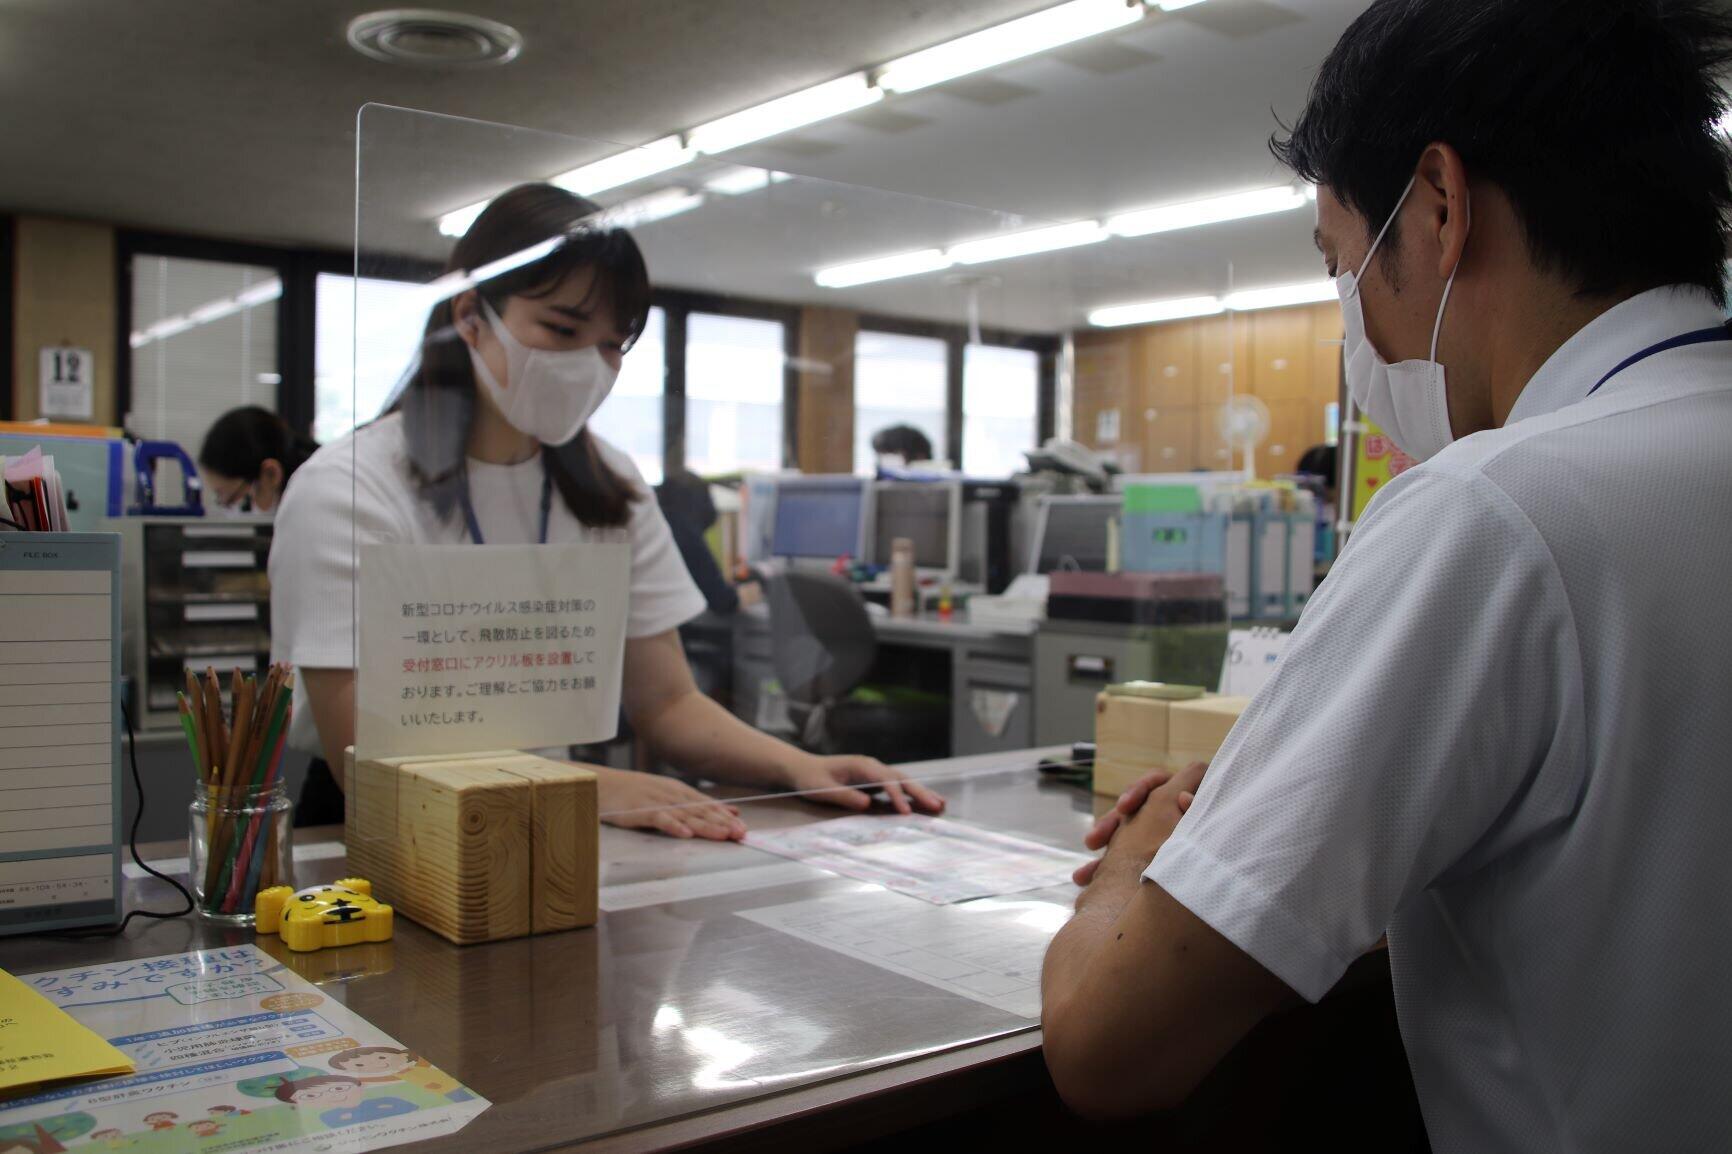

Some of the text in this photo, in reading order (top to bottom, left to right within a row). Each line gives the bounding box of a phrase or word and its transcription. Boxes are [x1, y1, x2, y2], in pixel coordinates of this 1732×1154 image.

[401, 598, 596, 617] 新型コロナウイルス感染症対策の
[401, 625, 596, 645] 一環として、飛散防止を図るため
[402, 650, 596, 673] 受付窓口にアクリル板を設置して
[401, 676, 596, 700] おります。ご理解とご協力をお願
[401, 709, 485, 727] いいたします。
